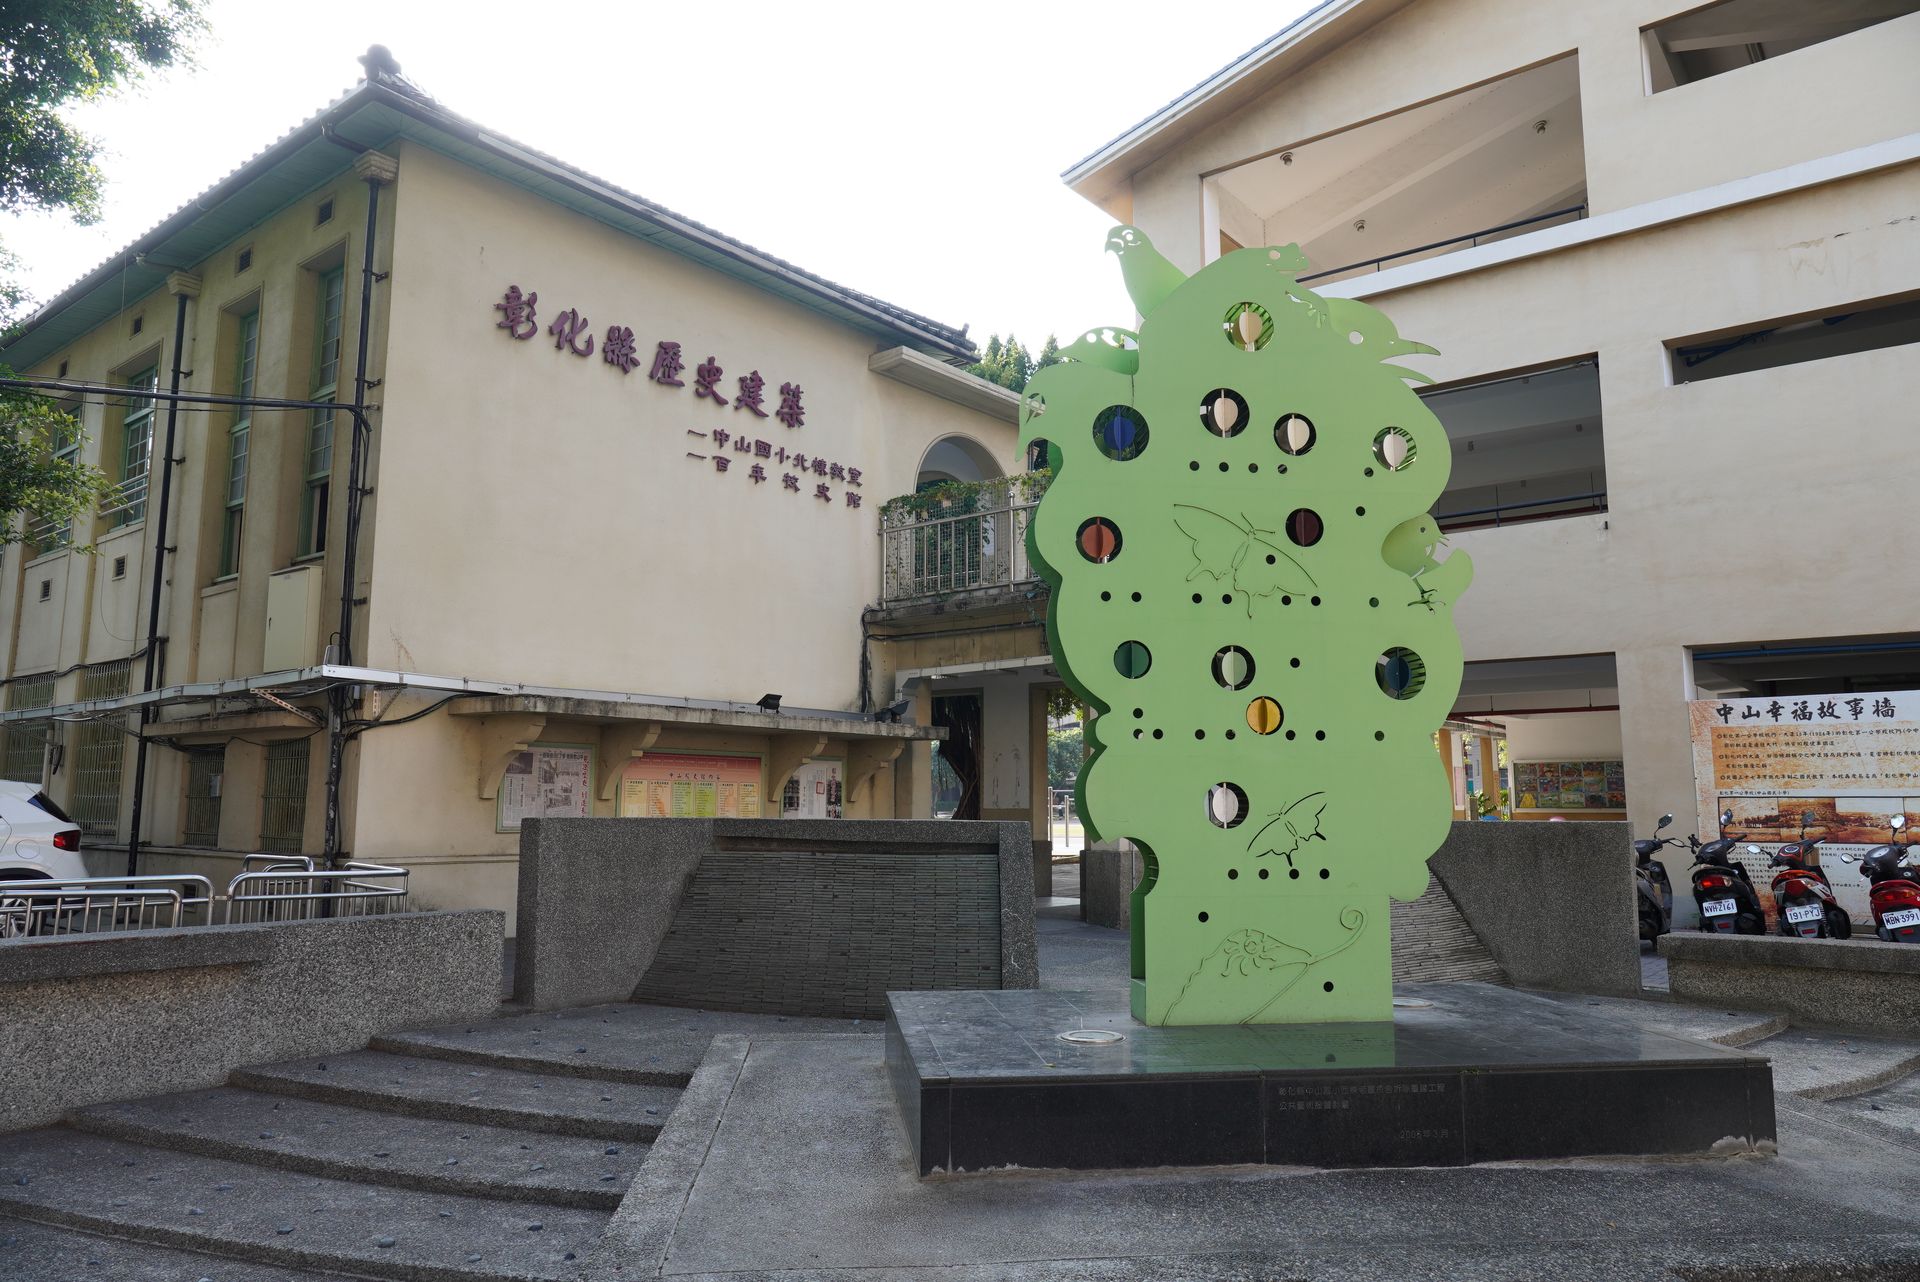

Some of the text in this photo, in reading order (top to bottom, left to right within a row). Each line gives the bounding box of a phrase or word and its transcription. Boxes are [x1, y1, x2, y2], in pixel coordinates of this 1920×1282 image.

[493, 284, 806, 428] 彰化縣歷史建築
[1716, 697, 1897, 724] 中山幸福故事牆
[1704, 902, 1735, 914] NVH-2161
[1789, 909, 1821, 921] 191-PYJ
[1884, 912, 1920, 926] MBN-3991
